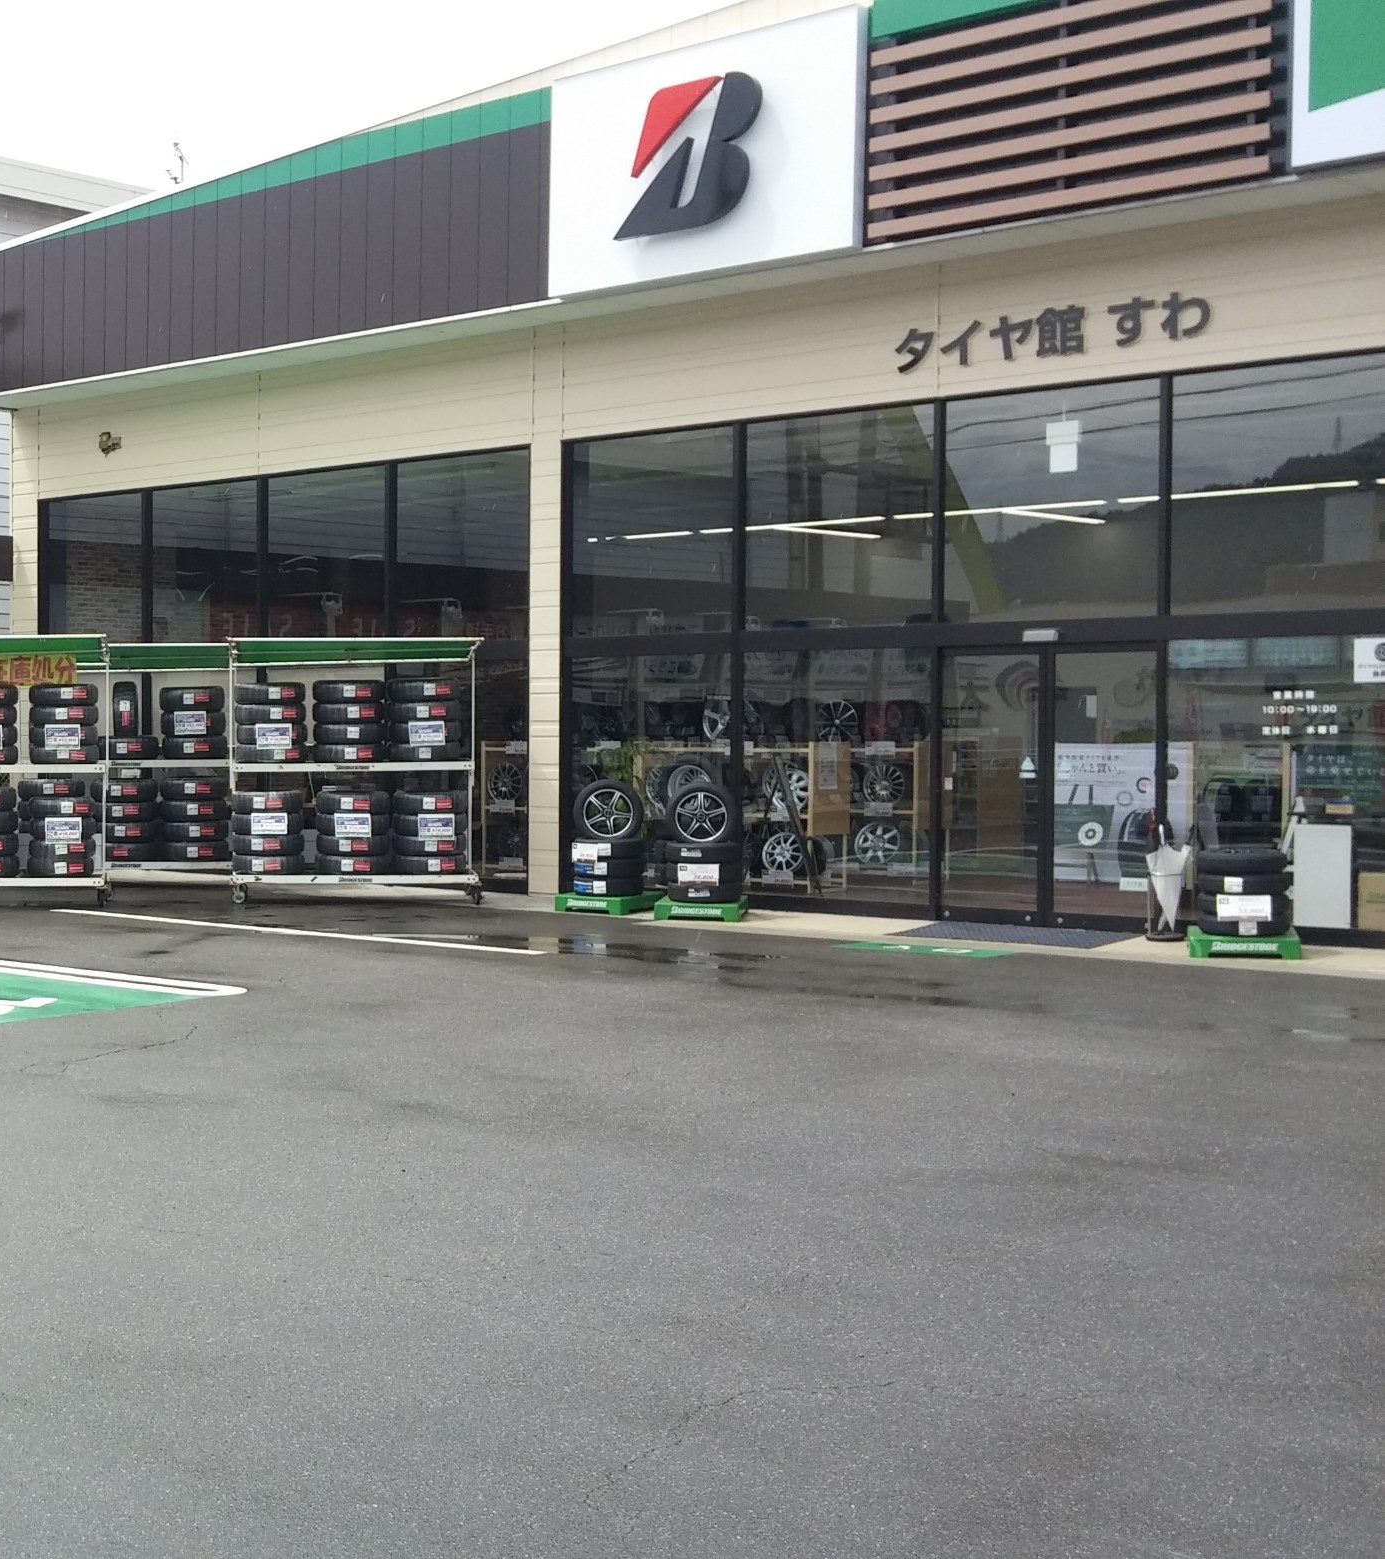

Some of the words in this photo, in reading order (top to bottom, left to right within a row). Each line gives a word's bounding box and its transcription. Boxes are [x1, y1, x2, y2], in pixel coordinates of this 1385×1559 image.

[894, 306, 1085, 374] タイヤ館
[1107, 292, 1211, 347] すわ
[567, 898, 608, 908] BRIDGESTONE
[671, 905, 723, 915] BRIDGESTONE
[1211, 941, 1279, 952] BRIDGESTONE
